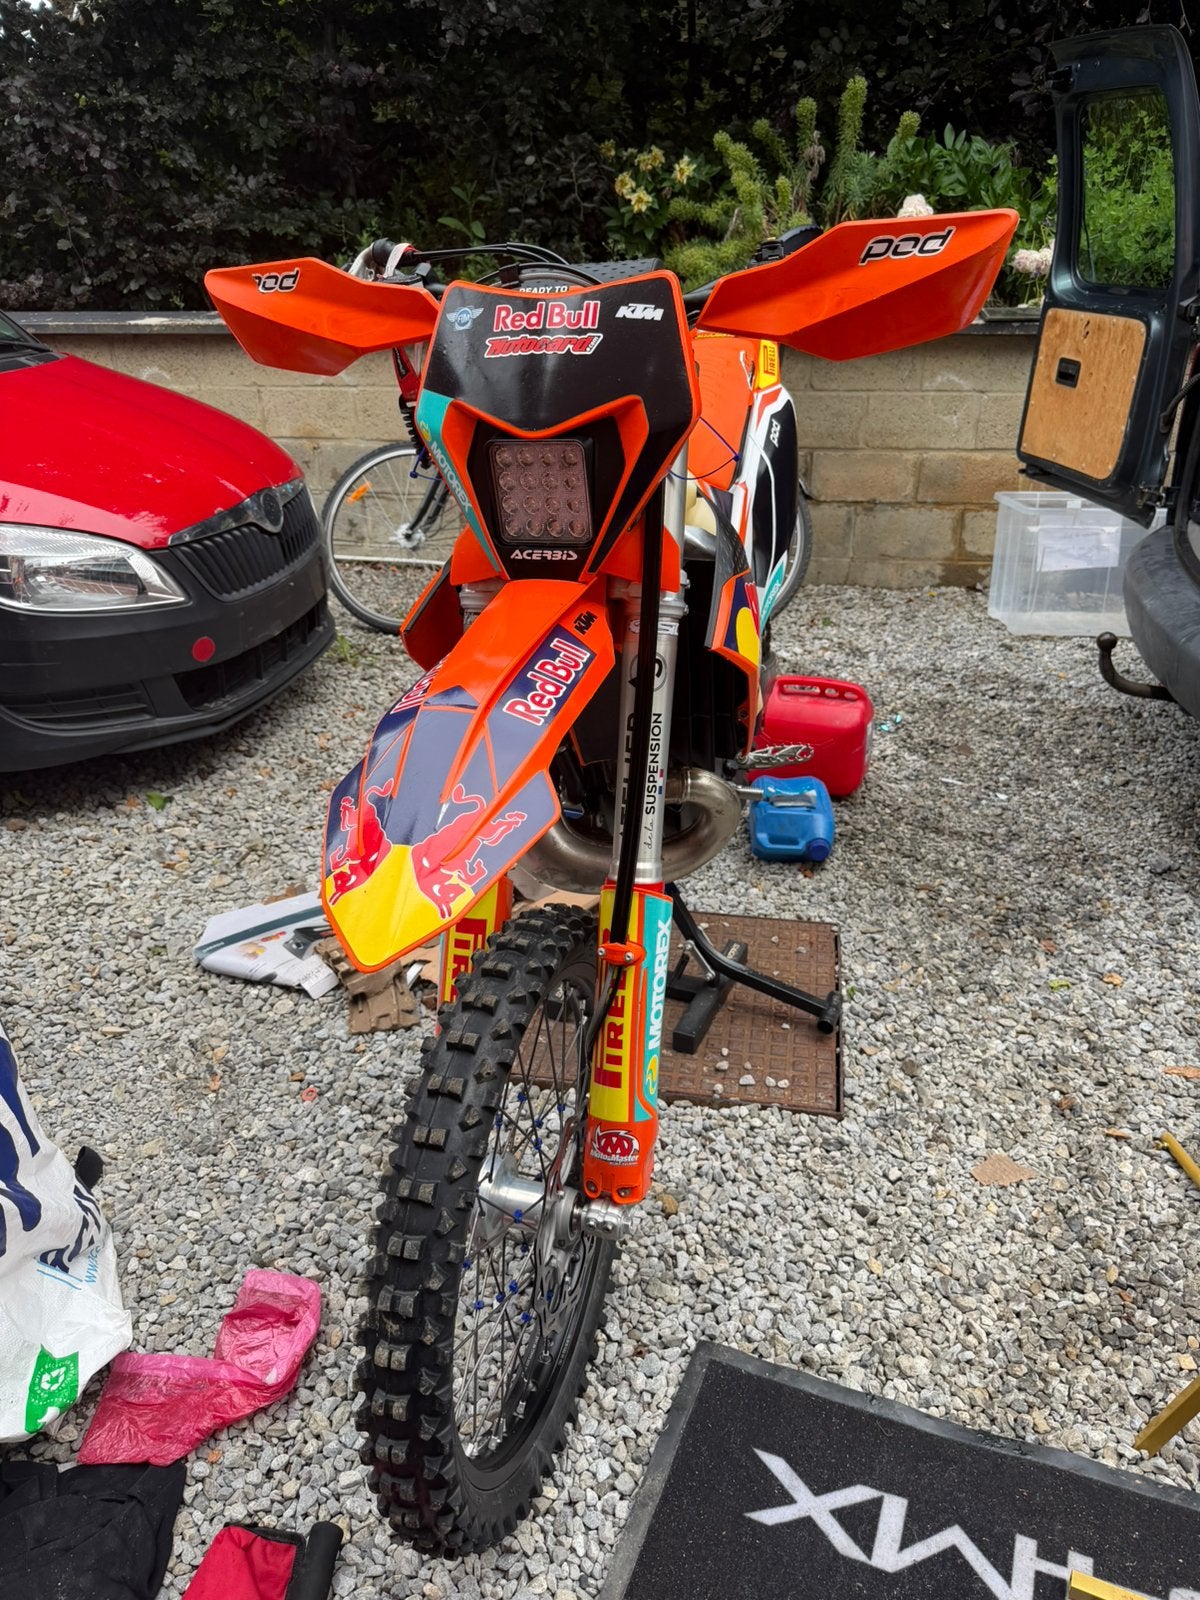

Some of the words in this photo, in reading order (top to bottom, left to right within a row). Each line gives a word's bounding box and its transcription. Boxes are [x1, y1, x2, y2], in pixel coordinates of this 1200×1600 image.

[858, 226, 956, 266] pod
[555, 285, 568, 293] TO
[493, 302, 545, 332] Red
[546, 301, 600, 329] Bull
[615, 303, 664, 321] KTM
[763, 345, 776, 376] PIRELLI
[430, 441, 473, 513] MOTOREX
[573, 610, 598, 635] KTM
[503, 671, 566, 726] Red
[535, 638, 590, 684] Bull
[645, 712, 663, 815] SUSPENSION
[648, 919, 672, 1050] MOTOREX
